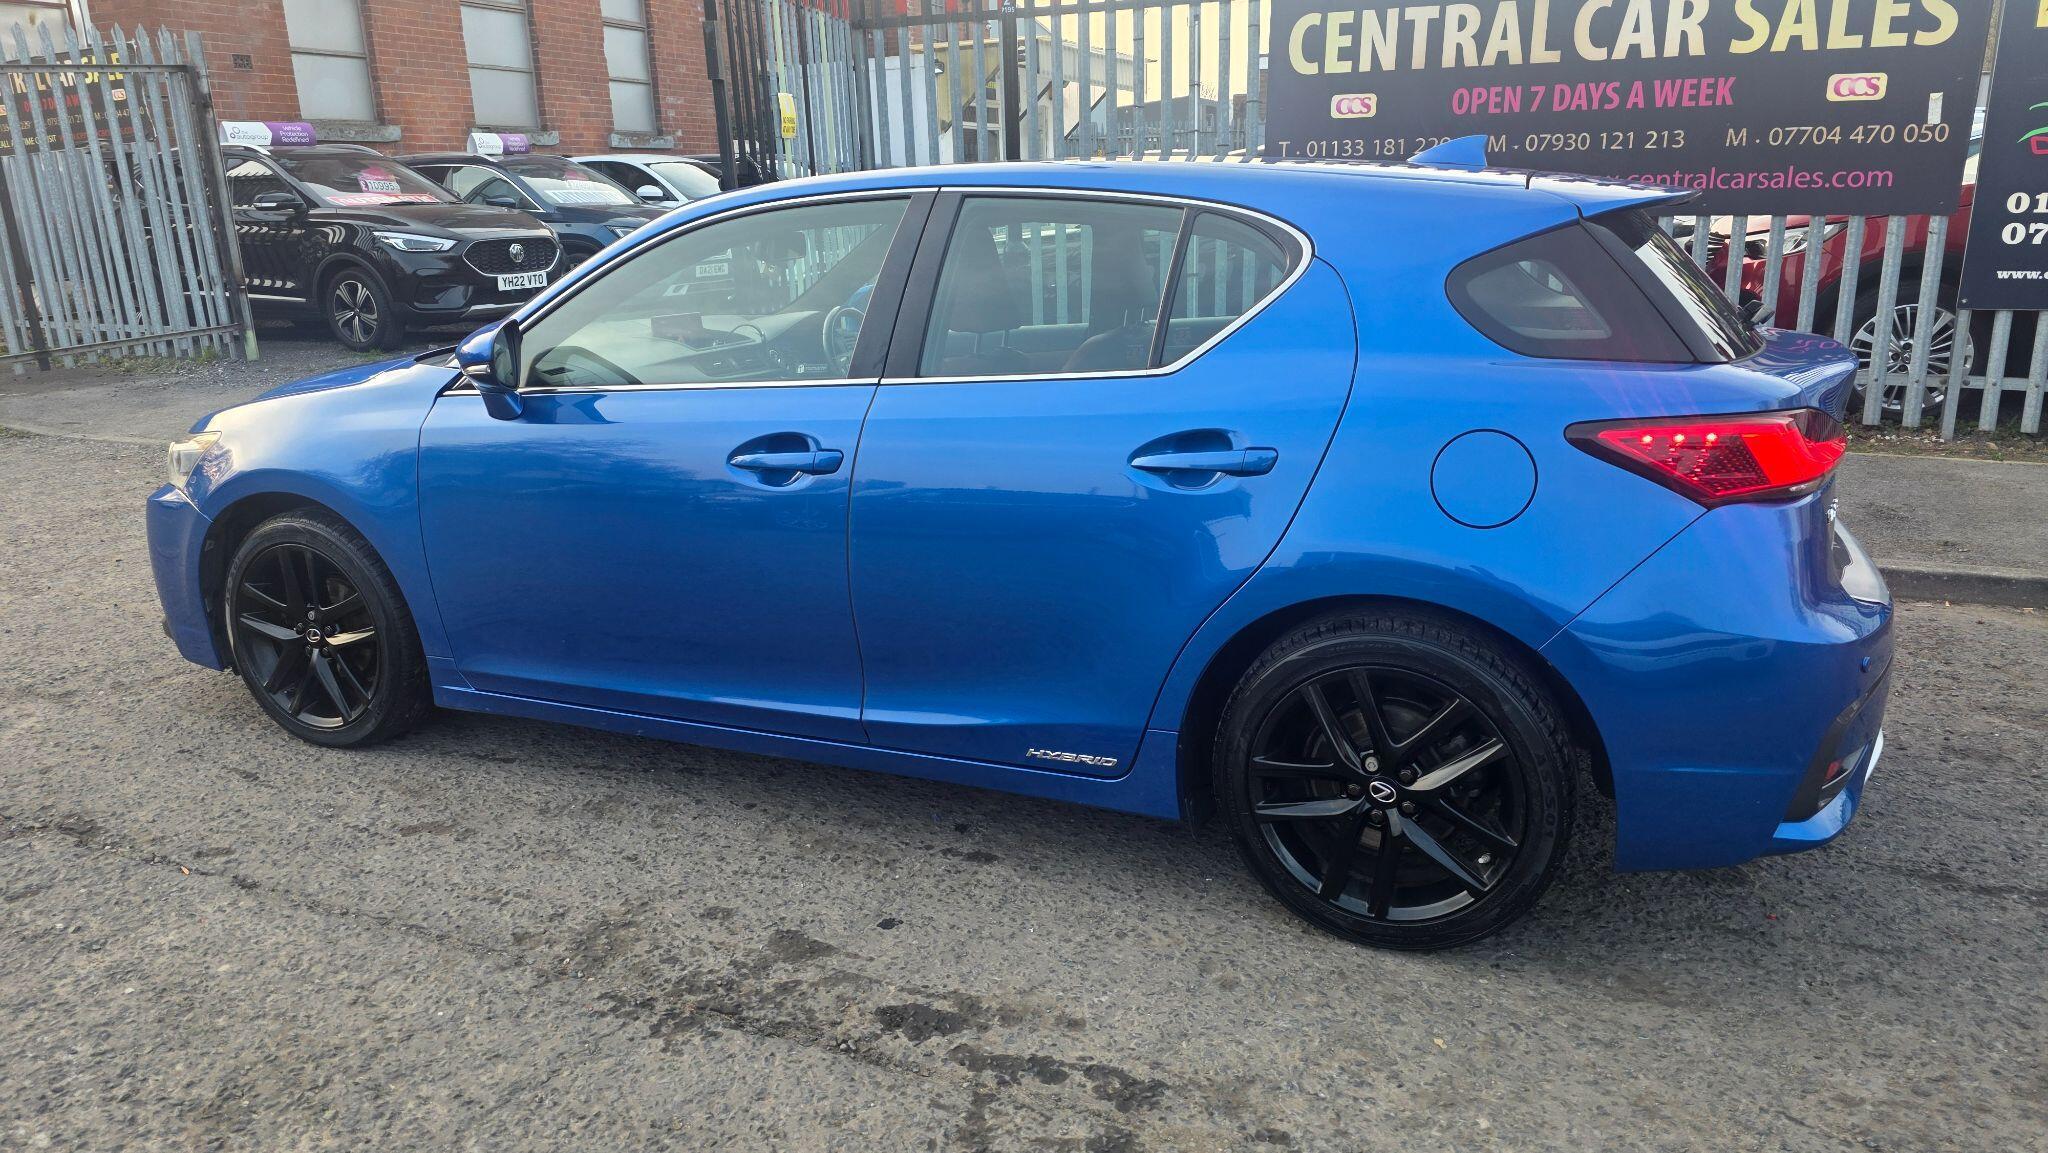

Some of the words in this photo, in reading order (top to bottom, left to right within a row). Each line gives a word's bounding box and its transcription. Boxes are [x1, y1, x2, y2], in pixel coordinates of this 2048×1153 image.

[1288, 0, 1561, 75] CENTRAL
[1573, 0, 1710, 61] CAR
[1729, 0, 1960, 54] SALES
[1452, 85, 1522, 115] OPEN
[1529, 85, 1546, 112] 7
[1552, 81, 1621, 112] DAYS
[1626, 80, 1645, 109] A
[1653, 77, 1737, 107] WEEK
[1525, 132, 1591, 152] 07930
[1600, 131, 1634, 150] 121
[1644, 130, 1685, 149] 213
[1768, 126, 1842, 146] 07704
[1850, 124, 1896, 145] 470
[1903, 123, 1950, 143] 050
[1306, 139, 1365, 158] 01133
[1373, 138, 1405, 156] 181
[502, 275, 526, 288] YH22
[527, 274, 544, 286] VTO
[1026, 748, 1118, 766] HYBRID
